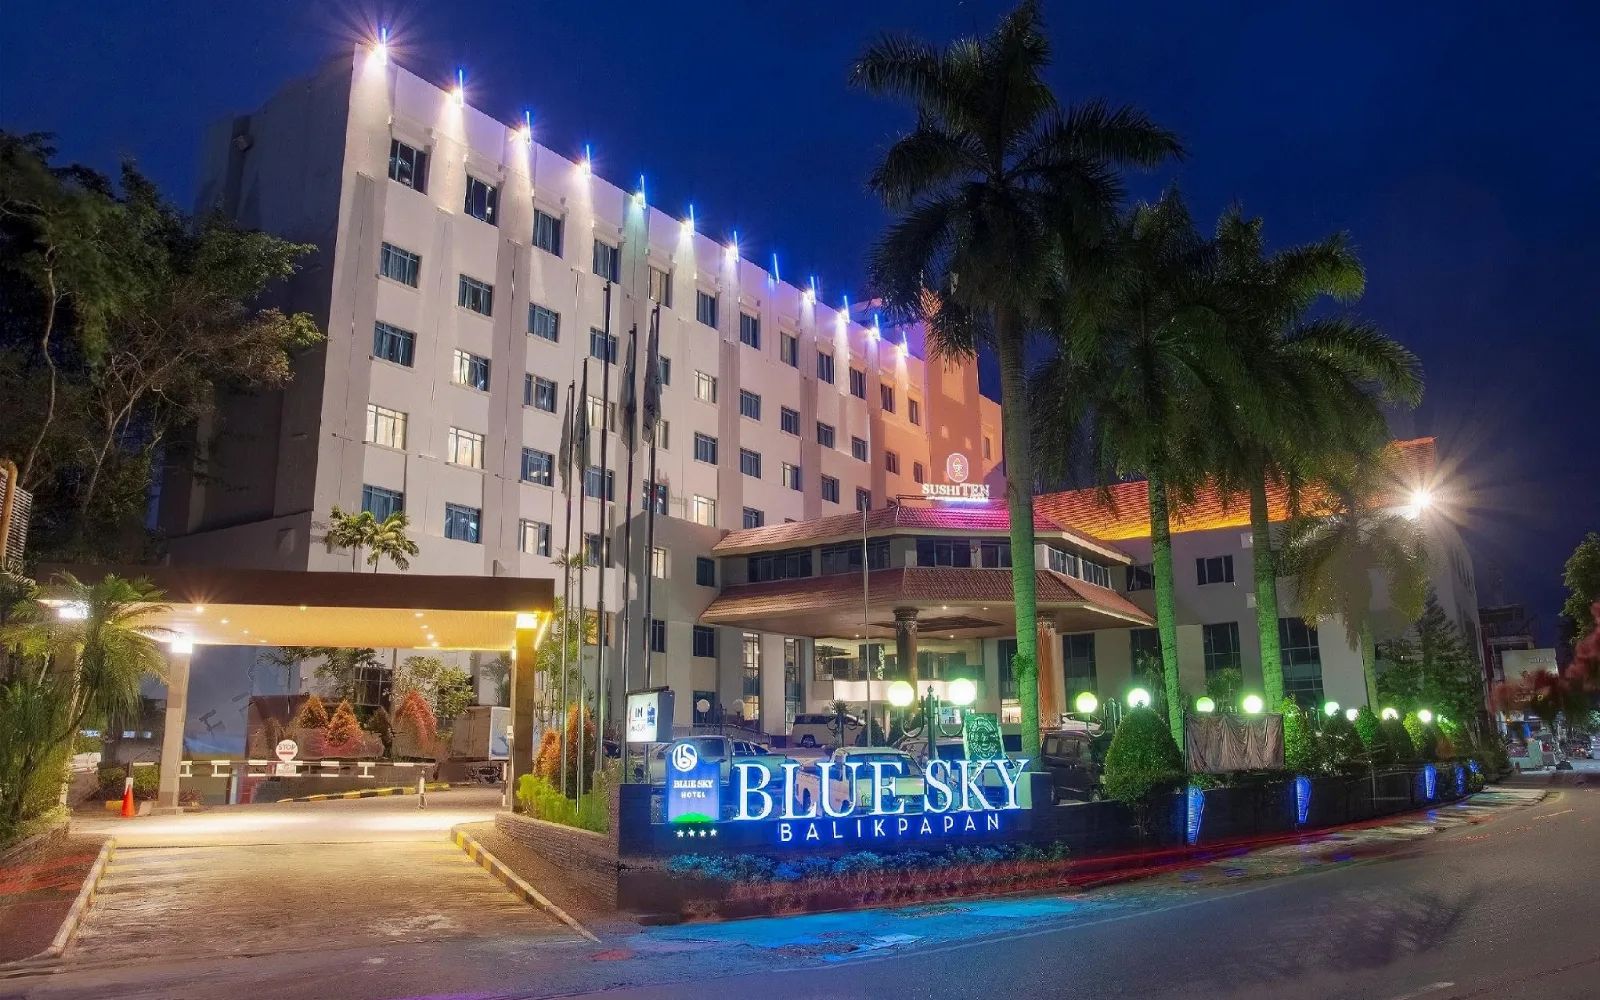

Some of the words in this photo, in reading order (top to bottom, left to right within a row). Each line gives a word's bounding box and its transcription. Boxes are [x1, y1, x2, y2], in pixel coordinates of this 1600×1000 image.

[922, 483, 960, 496] SUSHI
[960, 482, 990, 497] TEN
[635, 707, 643, 717] IN
[673, 780, 697, 788] BLUE
[697, 780, 713, 788] SKY
[732, 762, 905, 821] BLUE
[923, 758, 1029, 814] SKY
[779, 813, 1000, 842] BALIKPAPAN
